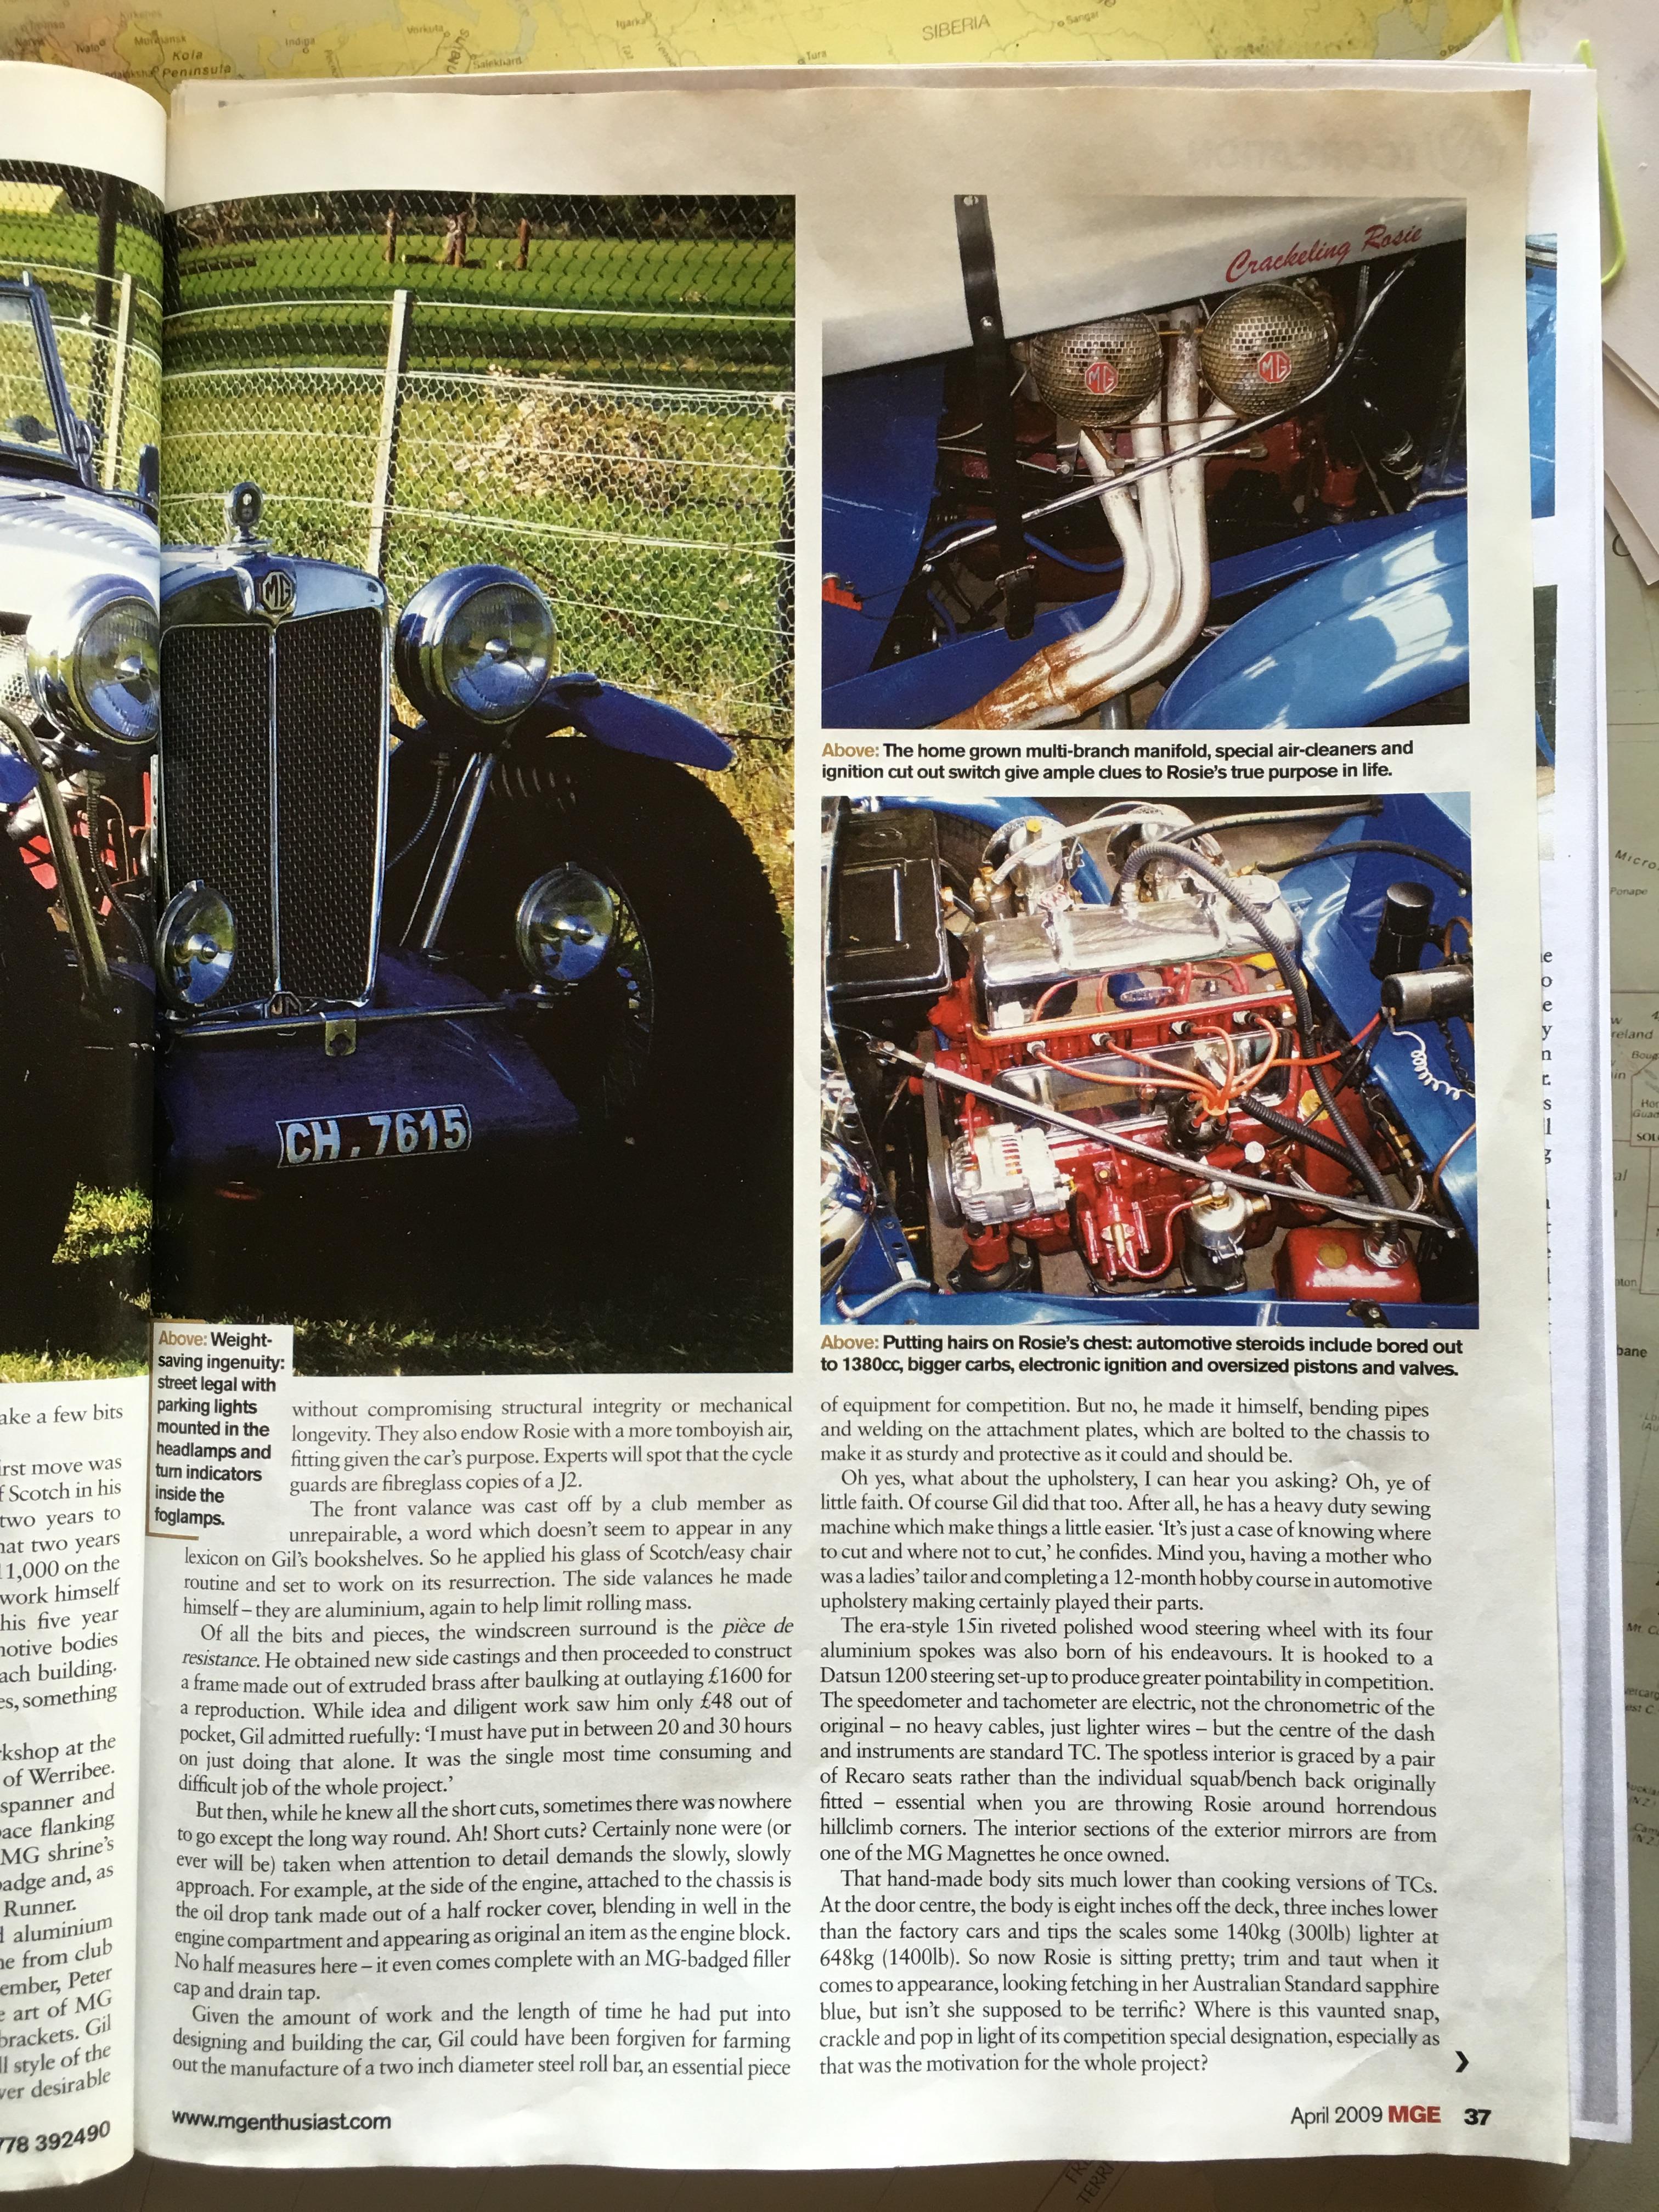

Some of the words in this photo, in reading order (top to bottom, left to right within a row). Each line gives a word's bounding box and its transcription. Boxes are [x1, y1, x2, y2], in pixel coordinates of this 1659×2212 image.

[922, 14, 990, 41] SIBERIA
[172, 50, 203, 61] Kola
[162, 64, 232, 78] Peninsula
[1225, 239, 1351, 284] Crackeling
[1361, 223, 1423, 253] Rosie
[822, 743, 879, 758] Above:
[882, 743, 914, 758] The
[918, 743, 966, 758] home
[969, 747, 1022, 761] grown
[1026, 743, 1130, 758] multi-branch
[1134, 743, 1211, 761] manifold,
[1215, 743, 1273, 761] special
[1278, 742, 1378, 757] air-cleaners
[1381, 740, 1414, 755] and
[822, 764, 884, 782] ignition
[888, 765, 914, 779] cut
[917, 765, 945, 779] out
[948, 765, 1001, 780] switch
[1005, 765, 1040, 783] give
[1042, 765, 1095, 783] ample
[1098, 765, 1142, 780] clues
[1145, 765, 1163, 780] to
[1166, 765, 1228, 780] Rosie's
[1230, 765, 1265, 779] true
[1268, 766, 1339, 782] purpose
[1342, 763, 1358, 778] in
[1362, 762, 1393, 777] life.
[1614, 849, 1659, 871] Micro
[1610, 887, 1648, 896] Ponape
[1610, 1029, 1654, 1040] reland
[159, 1330, 207, 1346] Above:
[211, 1332, 272, 1350] Weight-
[821, 1334, 879, 1350] Above:
[883, 1334, 943, 1353] Putting
[947, 1335, 989, 1350] hairs
[992, 1338, 1014, 1350] on
[1018, 1335, 1080, 1350] Rosie's
[1082, 1335, 1132, 1350] chest:
[1136, 1335, 1233, 1351] automotive
[1235, 1336, 1305, 1352] steroids
[1309, 1336, 1373, 1353] include
[1376, 1338, 1429, 1354] bored
[1432, 1339, 1464, 1355] out
[158, 1353, 202, 1370] saving
[207, 1354, 285, 1372] ingenuity:
[820, 1357, 838, 1372] to
[842, 1357, 904, 1374] 1380cc,
[907, 1356, 962, 1375] bigger
[964, 1357, 1015, 1375] carbs,
[1018, 1357, 1101, 1372] electronic
[1104, 1357, 1167, 1376] ignition
[1171, 1357, 1203, 1373] and
[1207, 1358, 1289, 1373] oversized
[1294, 1358, 1358, 1377] pistons
[1362, 1360, 1395, 1375] and
[1399, 1361, 1459, 1376] valves.
[157, 1376, 197, 1390] street
[201, 1376, 237, 1394] legal
[241, 1378, 276, 1391] with
[157, 1398, 210, 1416] parking
[215, 1399, 257, 1417] lights
[291, 1400, 359, 1418] without
[367, 1399, 492, 1421] compromising
[501, 1396, 583, 1415] structural
[592, 1397, 662, 1418] integrity
[671, 1402, 690, 1413] or
[699, 1395, 793, 1413] mechanical
[157, 1421, 220, 1435] mounted
[225, 1421, 239, 1436] in
[244, 1422, 270, 1436] the
[156, 1441, 236, 1461] headlamps
[240, 1444, 271, 1459] and
[156, 1463, 182, 1478] turn
[187, 1465, 262, 1481] indicators
[155, 1486, 196, 1501] inside
[200, 1488, 224, 1503] the
[155, 1507, 225, 1528] foglamps.
[0, 1586, 49, 1605] work
[54, 1577, 121, 1602] himself
[180, 1703, 189, 1715] a
[194, 1701, 305, 1722] reproduction.
[312, 1701, 364, 1719] While
[370, 1700, 407, 1719] idea
[413, 1698, 447, 1718] and
[453, 1697, 518, 1719] diligent
[523, 1695, 570, 1713] work
[577, 1700, 610, 1712] saw
[616, 1693, 650, 1711] him
[656, 1692, 694, 1714] only
[699, 1691, 732, 1709] £48
[740, 1695, 769, 1708] out
[774, 1690, 794, 1708] of
[3, 1768, 24, 1787] of
[28, 1762, 115, 1785] Werribee.
[0, 1795, 75, 1818] spanner
[82, 1782, 115, 1805] and
[1, 1846, 40, 1865] MG
[48, 1836, 114, 1862] shrine's
[820, 1849, 851, 1861] one
[854, 1842, 873, 1861] of
[876, 1843, 902, 1861] the
[906, 1844, 943, 1861] MG
[946, 1844, 1036, 1866] Magnettes
[1039, 1844, 1059, 1862] he
[1063, 1850, 1103, 1863] once
[1107, 1844, 1170, 1863] owned.
[4, 1899, 76, 1917] Runner.
[820, 1947, 874, 1971] 648kg
[882, 1946, 960, 1970] (1400lb).
[968, 1948, 990, 1965] So
[997, 1953, 1036, 1965] now
[1043, 1948, 1091, 1966] Rosie
[1099, 1948, 1112, 1966] is
[1120, 1948, 1172, 1971] sitting
[1180, 1952, 1235, 1971] pretty;
[1243, 1949, 1280, 1966] trim
[1288, 1949, 1321, 1967] and
[1328, 1954, 1363, 1967] taut
[1370, 1950, 1419, 1969] when
[1427, 1953, 1440, 1970] it
[819, 2056, 854, 2075] that
[857, 2061, 891, 2074] was
[895, 2053, 922, 2073] the
[926, 2053, 1020, 2072] motivation
[1024, 2051, 1049, 2070] for
[1053, 2052, 1080, 2071] the
[1084, 2052, 1137, 2071] whole
[1141, 2053, 1208, 2076] project?
[172, 2110, 391, 2134] www.mgenthusiast.com
[1290, 2106, 1329, 2129] April
[1335, 2106, 1383, 2123] 2009
[1388, 2106, 1441, 2123] MGE
[1464, 2108, 1492, 2126] 37
[35, 2120, 111, 2151] 392490
